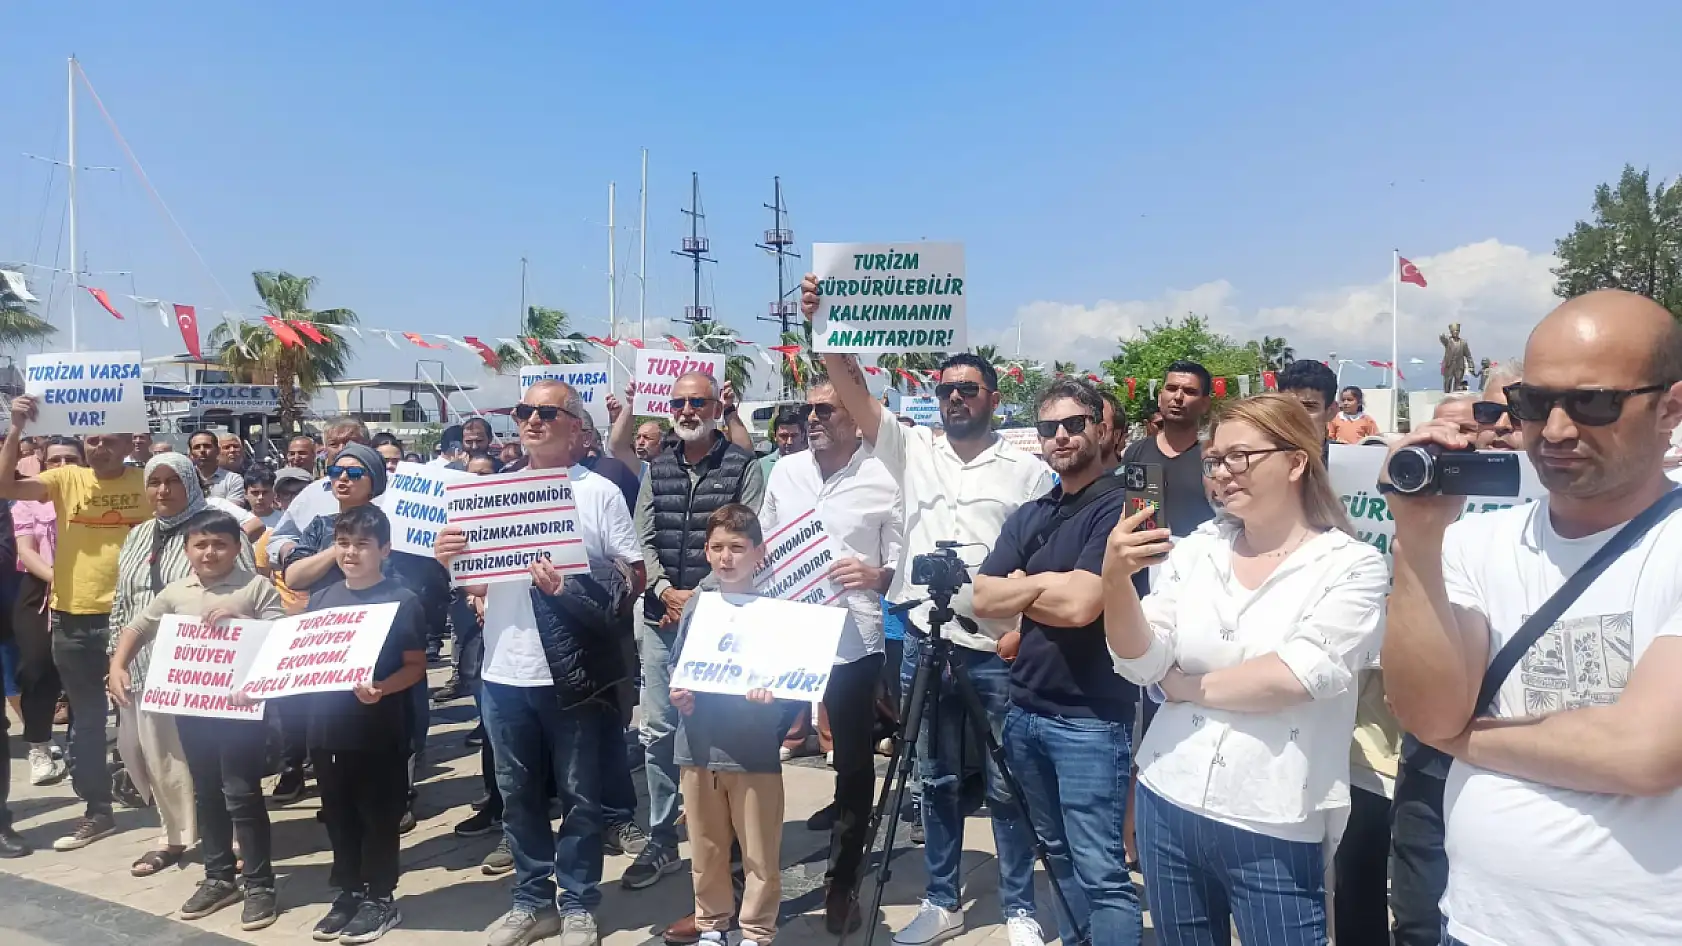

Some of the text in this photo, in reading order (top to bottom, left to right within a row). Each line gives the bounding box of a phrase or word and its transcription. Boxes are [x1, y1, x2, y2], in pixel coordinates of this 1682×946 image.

[854, 248, 919, 271] TURİZM
[816, 272, 963, 297] SÜRDÜRÜLEBİLİR
[828, 304, 953, 322] KALKINMANIN
[827, 329, 954, 347] ANAHTARIDIR!
[28, 361, 140, 381] TURİZM VARSA
[568, 372, 608, 386] VARSA
[45, 382, 123, 404] EKONOMİ
[192, 387, 262, 399] DOLCE
[68, 410, 106, 426] VAR!
[1444, 466, 1460, 474] HD
[390, 472, 432, 495] TURİZM
[447, 484, 573, 512] #TURİZMEKONOMİDİR
[395, 499, 447, 525] EKONOM
[406, 527, 437, 548] VAR!
[176, 621, 243, 641] TURİZMLE
[296, 610, 368, 632] TURİZMLE
[289, 629, 356, 650] BÜYÜYEN
[174, 643, 236, 664] BÜYÜYEN
[276, 645, 351, 671] EKONOMİ,
[168, 668, 234, 690] EKONOMİ,
[242, 666, 373, 695] GÜÇLÜ YARINLAR!
[144, 687, 180, 709] GÜÇLÜ
